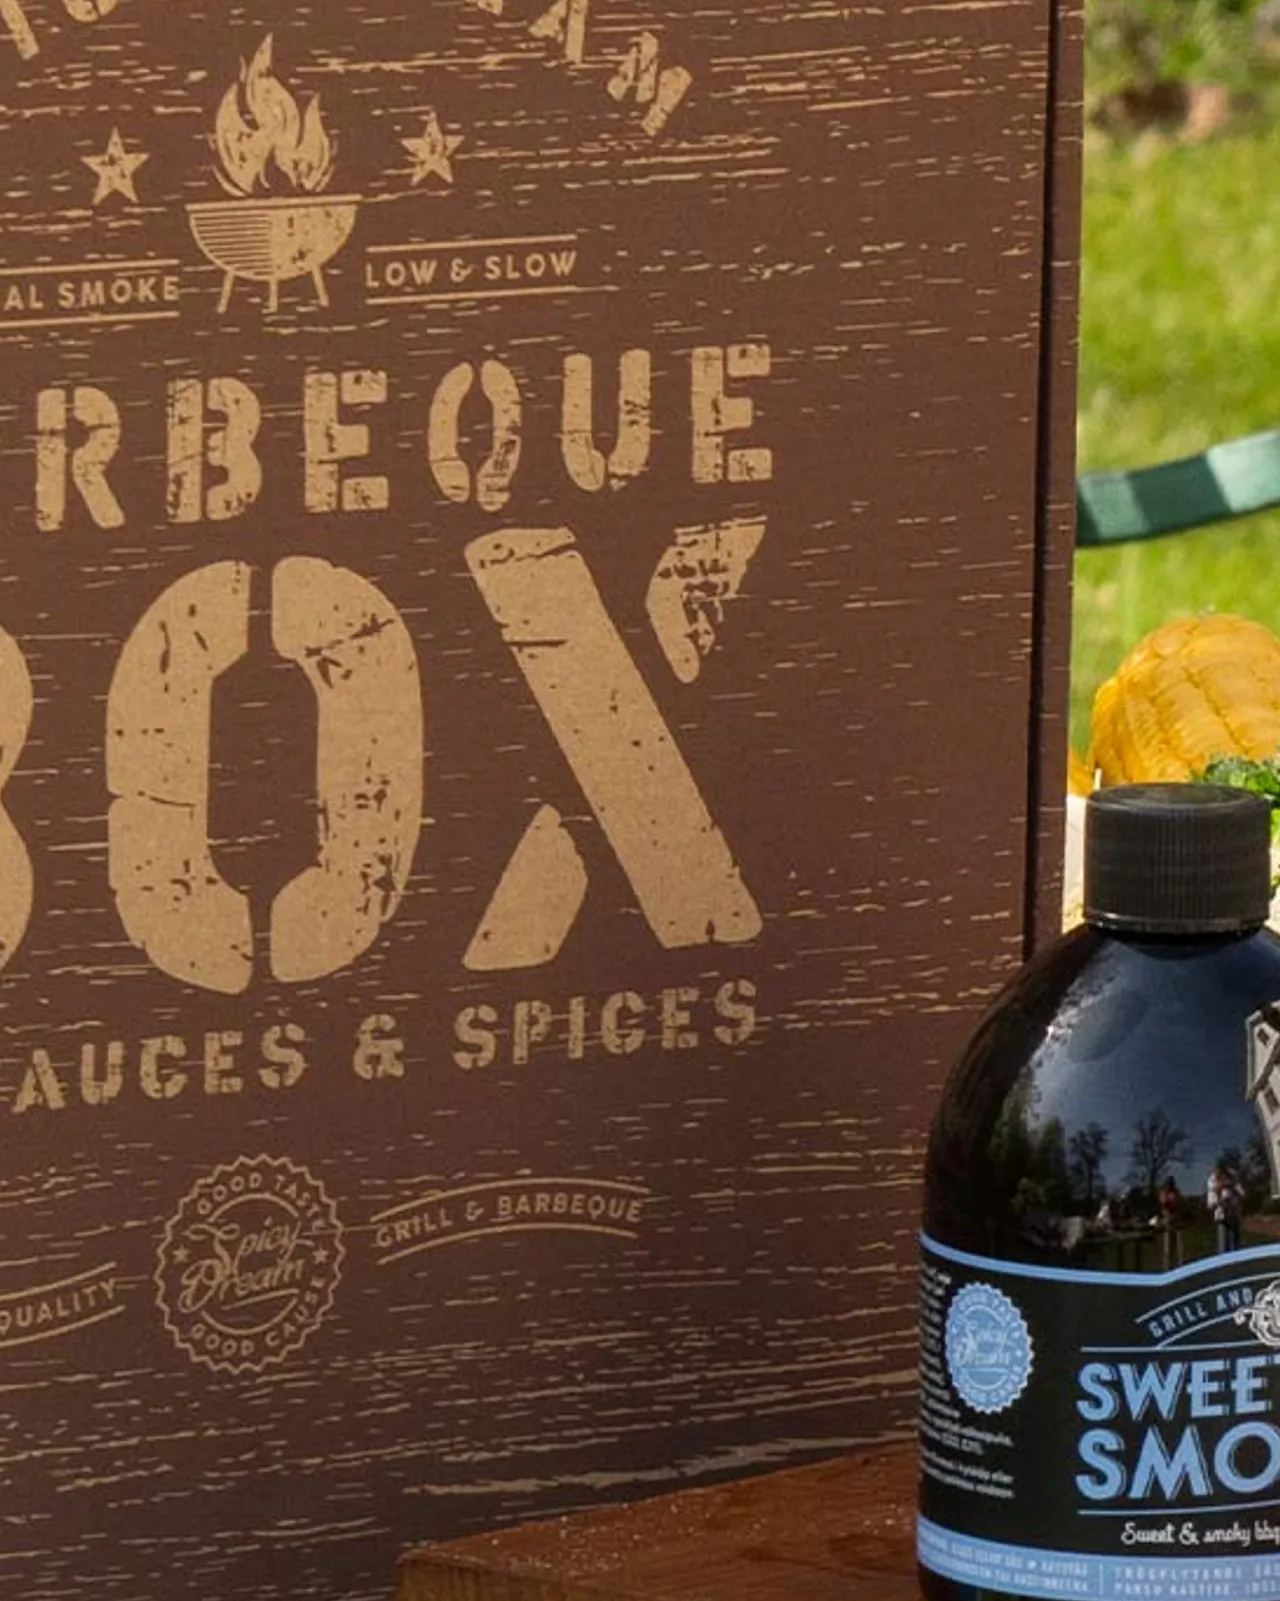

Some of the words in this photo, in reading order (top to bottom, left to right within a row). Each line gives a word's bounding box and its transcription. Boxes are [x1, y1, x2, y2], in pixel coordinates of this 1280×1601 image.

[57, 276, 181, 309] SMOKE
[365, 260, 437, 289] LOW
[450, 259, 477, 283] &
[485, 251, 578, 280] SLOW
[352, 1013, 406, 1080] &
[452, 978, 758, 1070] SPICES
[179, 1216, 315, 1275] Spicy
[375, 1207, 454, 1248] GRILL
[465, 1201, 484, 1222] &
[497, 1192, 644, 1223] BARBEQUE
[177, 1258, 305, 1314] Dream
[1148, 1302, 1208, 1338] GRILL
[1215, 1287, 1254, 1312] AND
[1121, 1520, 1176, 1546] Sweet
[1178, 1521, 1200, 1546] &
[1203, 1521, 1252, 1547] smoky
